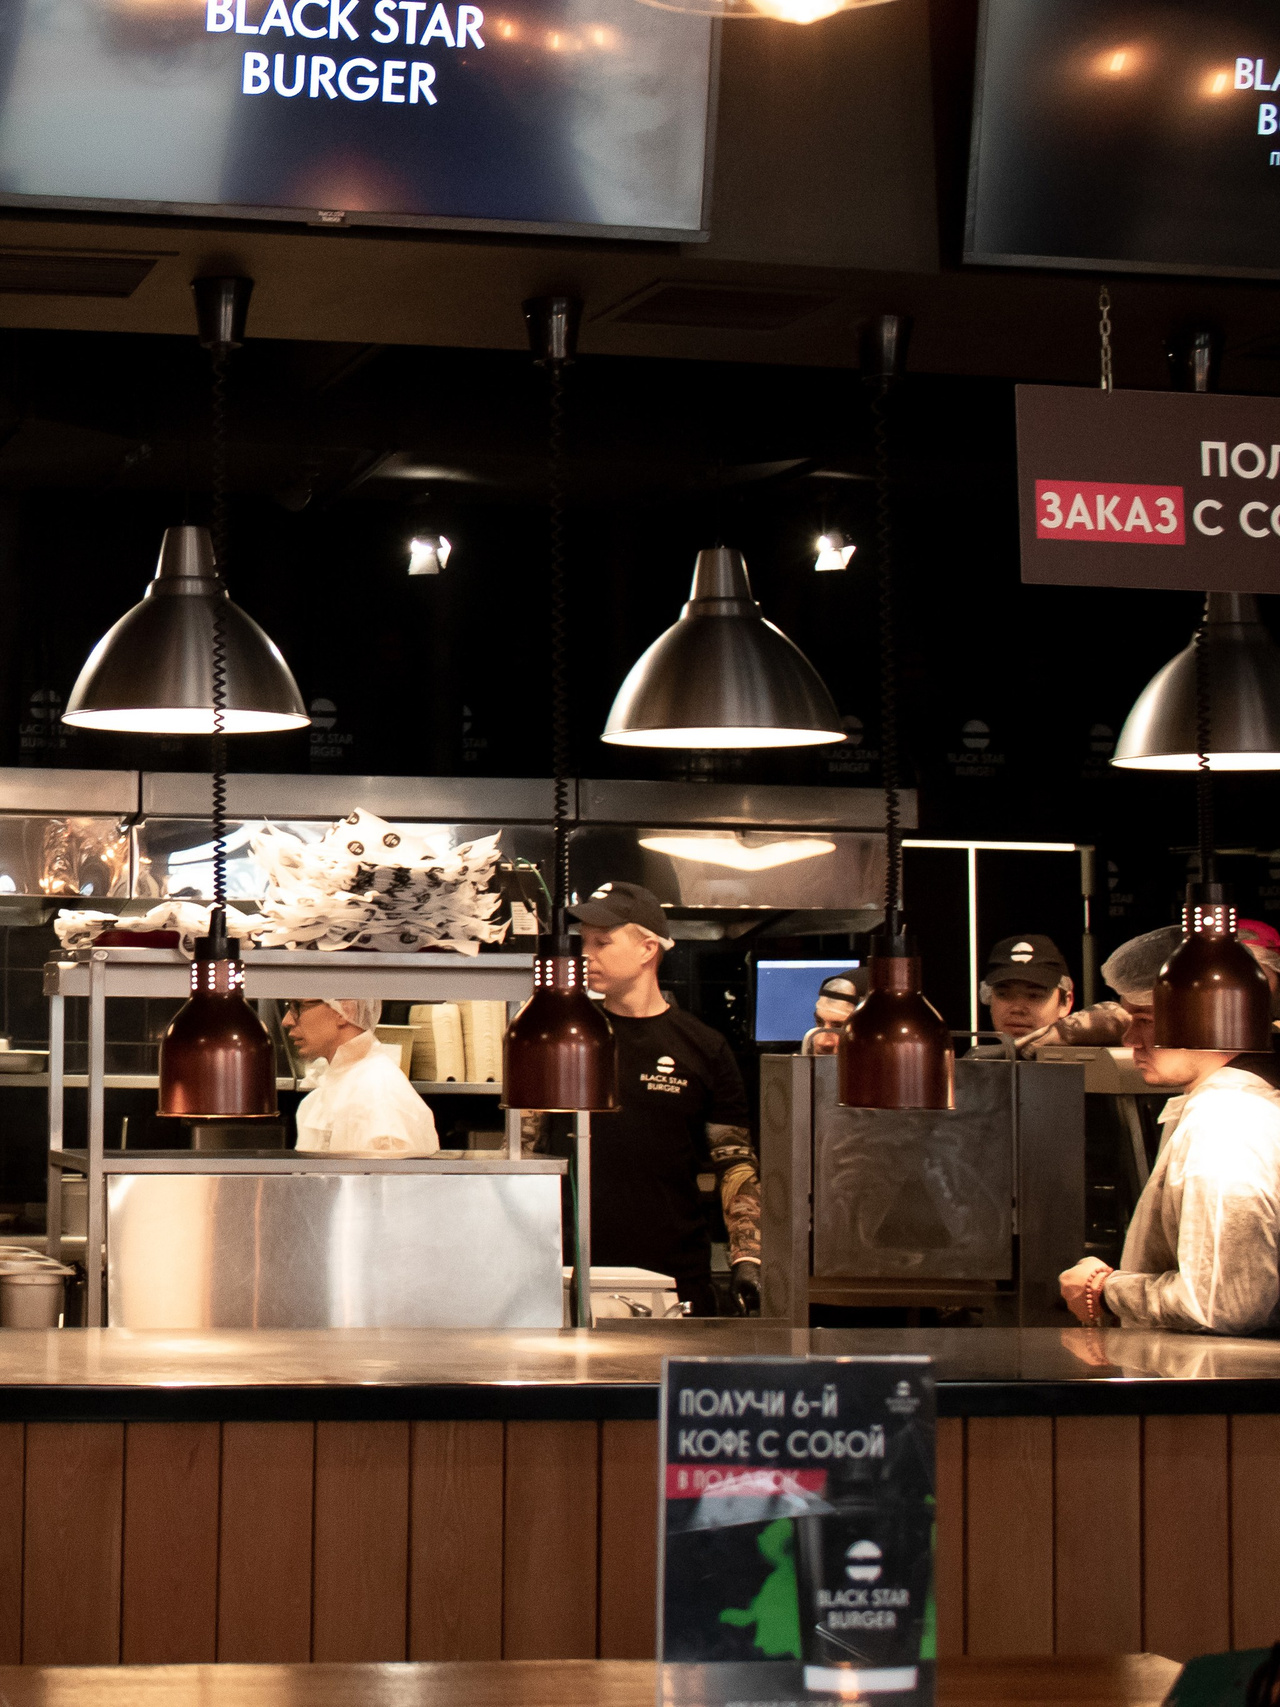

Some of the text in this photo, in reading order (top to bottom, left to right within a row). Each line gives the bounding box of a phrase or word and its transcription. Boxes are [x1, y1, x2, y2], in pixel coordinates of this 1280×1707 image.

[206, 0, 485, 50] BLACK STAR
[242, 51, 438, 106] BURGER
[1258, 103, 1280, 136] B
[1039, 490, 1280, 539] ЗАКАЗ С С
[310, 745, 345, 758] RGER
[326, 732, 354, 744] STAR
[640, 1072, 688, 1087] BLACK STAR
[646, 1083, 681, 1094] BURGER
[678, 1382, 839, 1419] ПОЛУЧИ 6-Й
[677, 1423, 887, 1460] КОФЕ С СОБОЙ
[816, 1587, 910, 1608] BLACK STAR
[827, 1610, 897, 1630] BURGER
